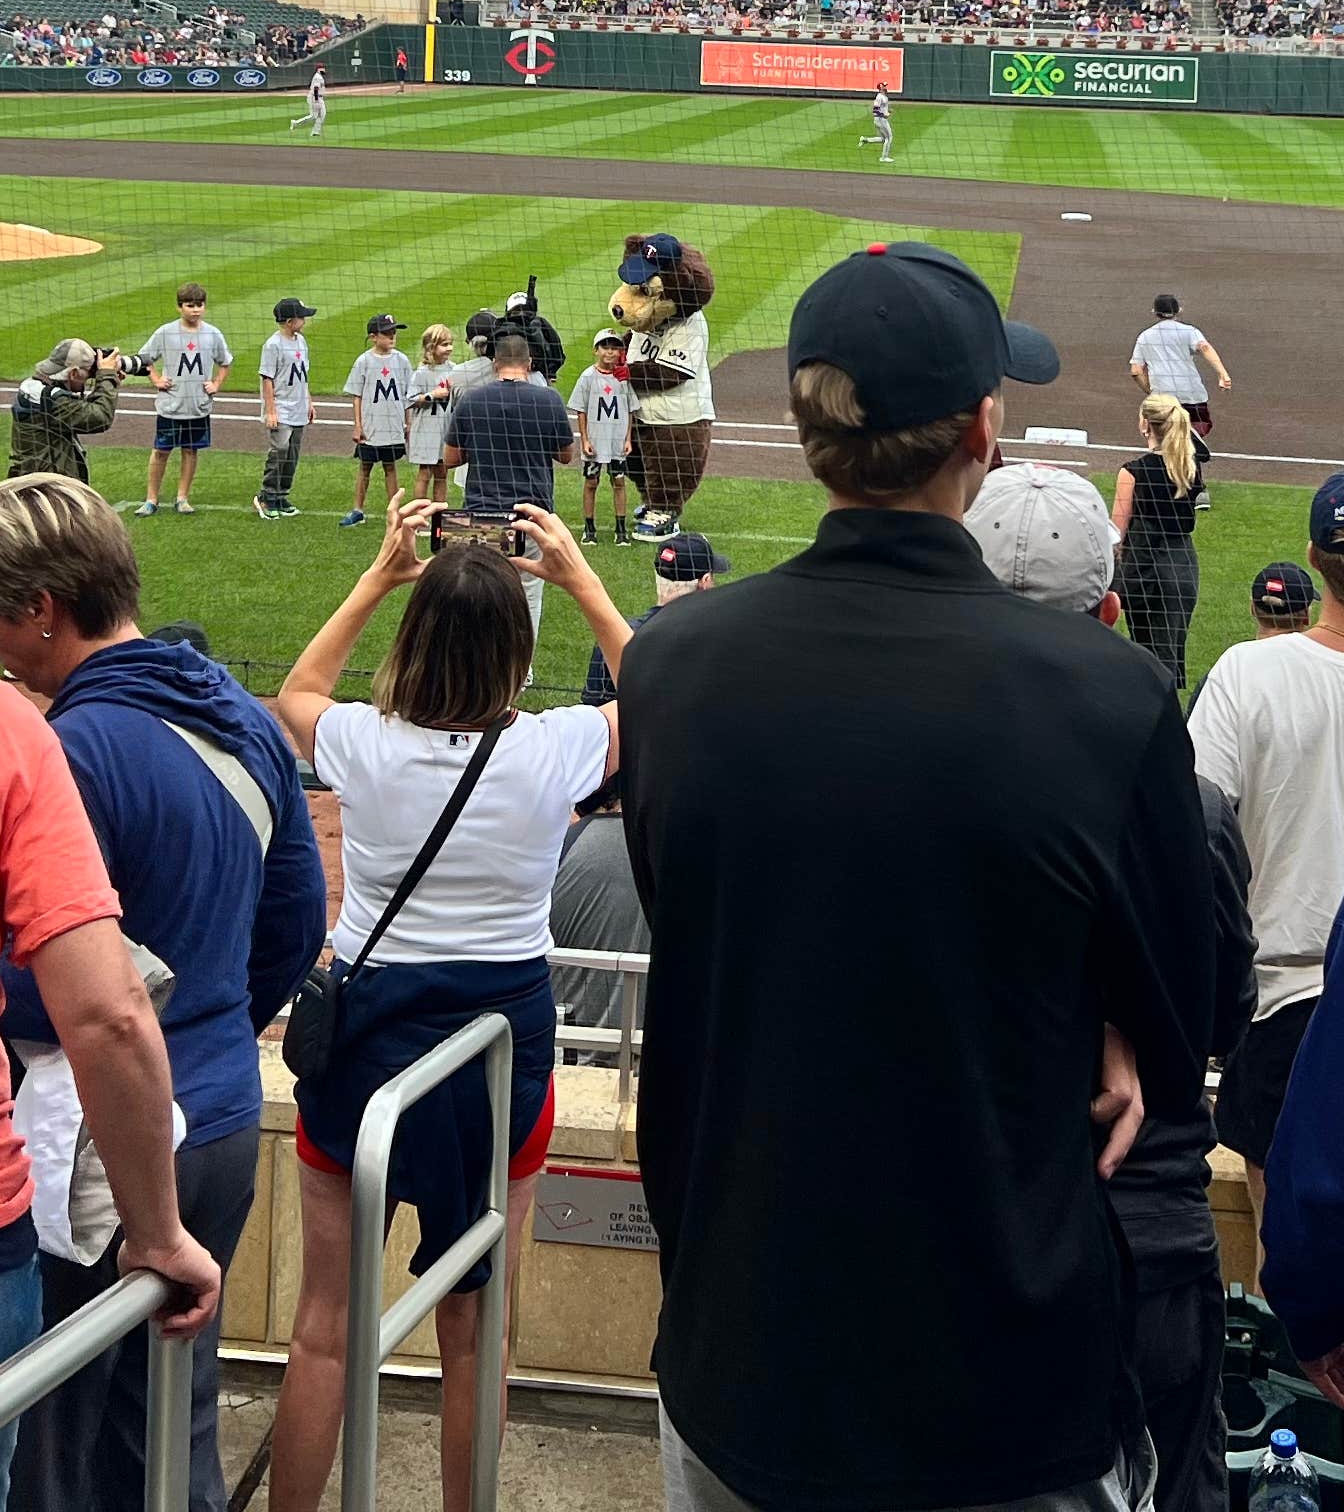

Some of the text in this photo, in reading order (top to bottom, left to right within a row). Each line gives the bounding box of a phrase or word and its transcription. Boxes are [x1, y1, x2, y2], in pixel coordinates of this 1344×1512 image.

[752, 51, 890, 72] Schneiderman's
[1073, 61, 1185, 82] securian
[444, 70, 471, 82] 339
[753, 70, 815, 80] FURNITURE
[1074, 82, 1153, 94] FINANCIAL
[640, 338, 660, 361] 00
[177, 352, 203, 377] M
[288, 360, 308, 387] M
[373, 380, 399, 404] M
[598, 396, 619, 421] M
[610, 1212, 624, 1222] OF
[610, 1223, 652, 1235] LEAVING
